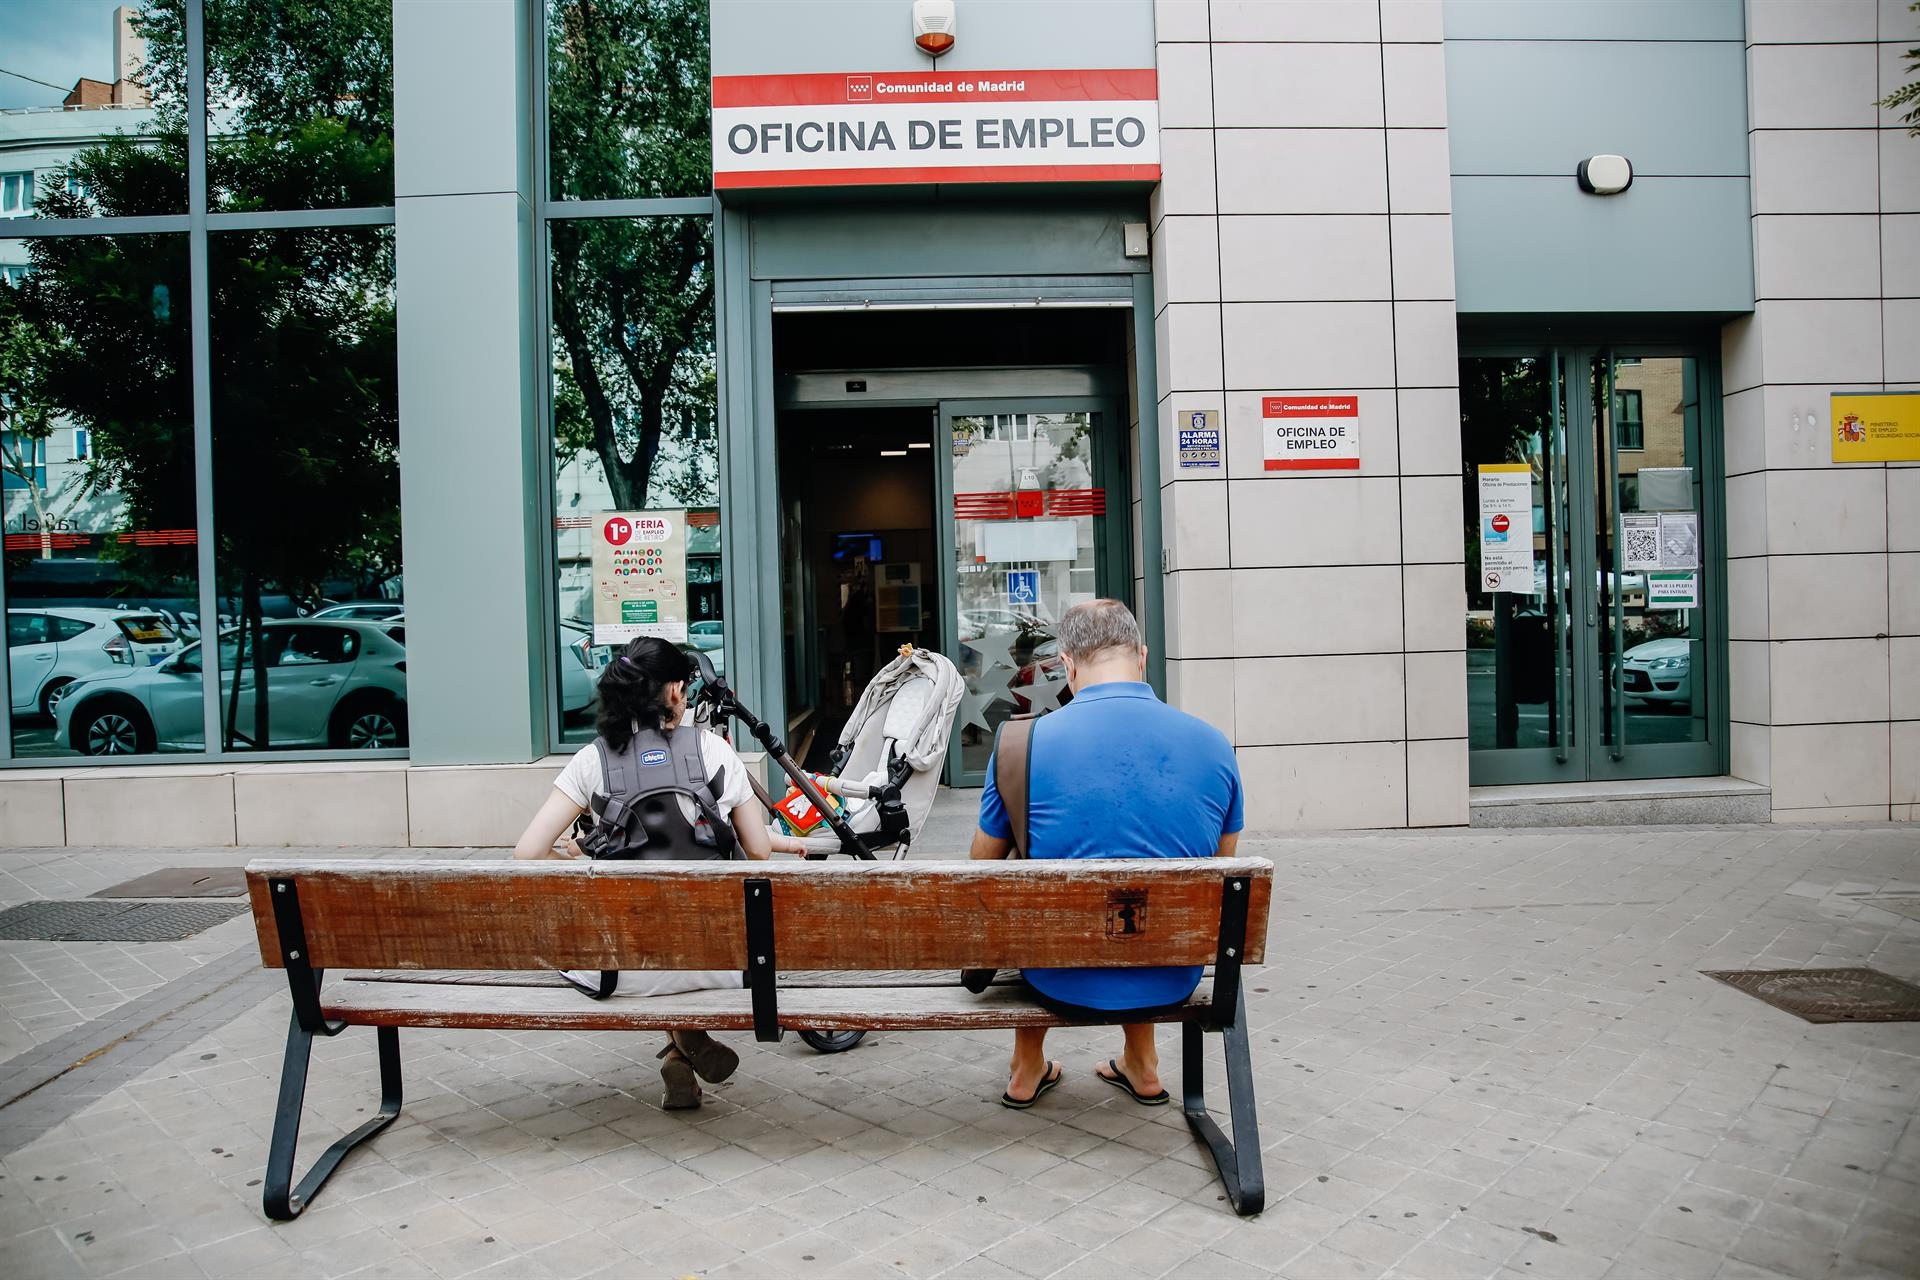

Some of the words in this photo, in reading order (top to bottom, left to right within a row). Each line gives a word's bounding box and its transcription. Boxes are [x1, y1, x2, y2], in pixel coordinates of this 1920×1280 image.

[876, 81, 953, 93] Comunidad
[957, 81, 974, 93] de
[978, 80, 1025, 92] Madrid
[728, 120, 896, 155] OFICINA
[908, 119, 963, 151] DE
[976, 117, 1146, 149] EMPLEO
[1181, 431, 1218, 439] ALARMA
[1276, 427, 1326, 437] OFICINA
[1329, 427, 1346, 437] DE
[1286, 439, 1337, 450] EMPLEO
[635, 520, 664, 529] FERIA
